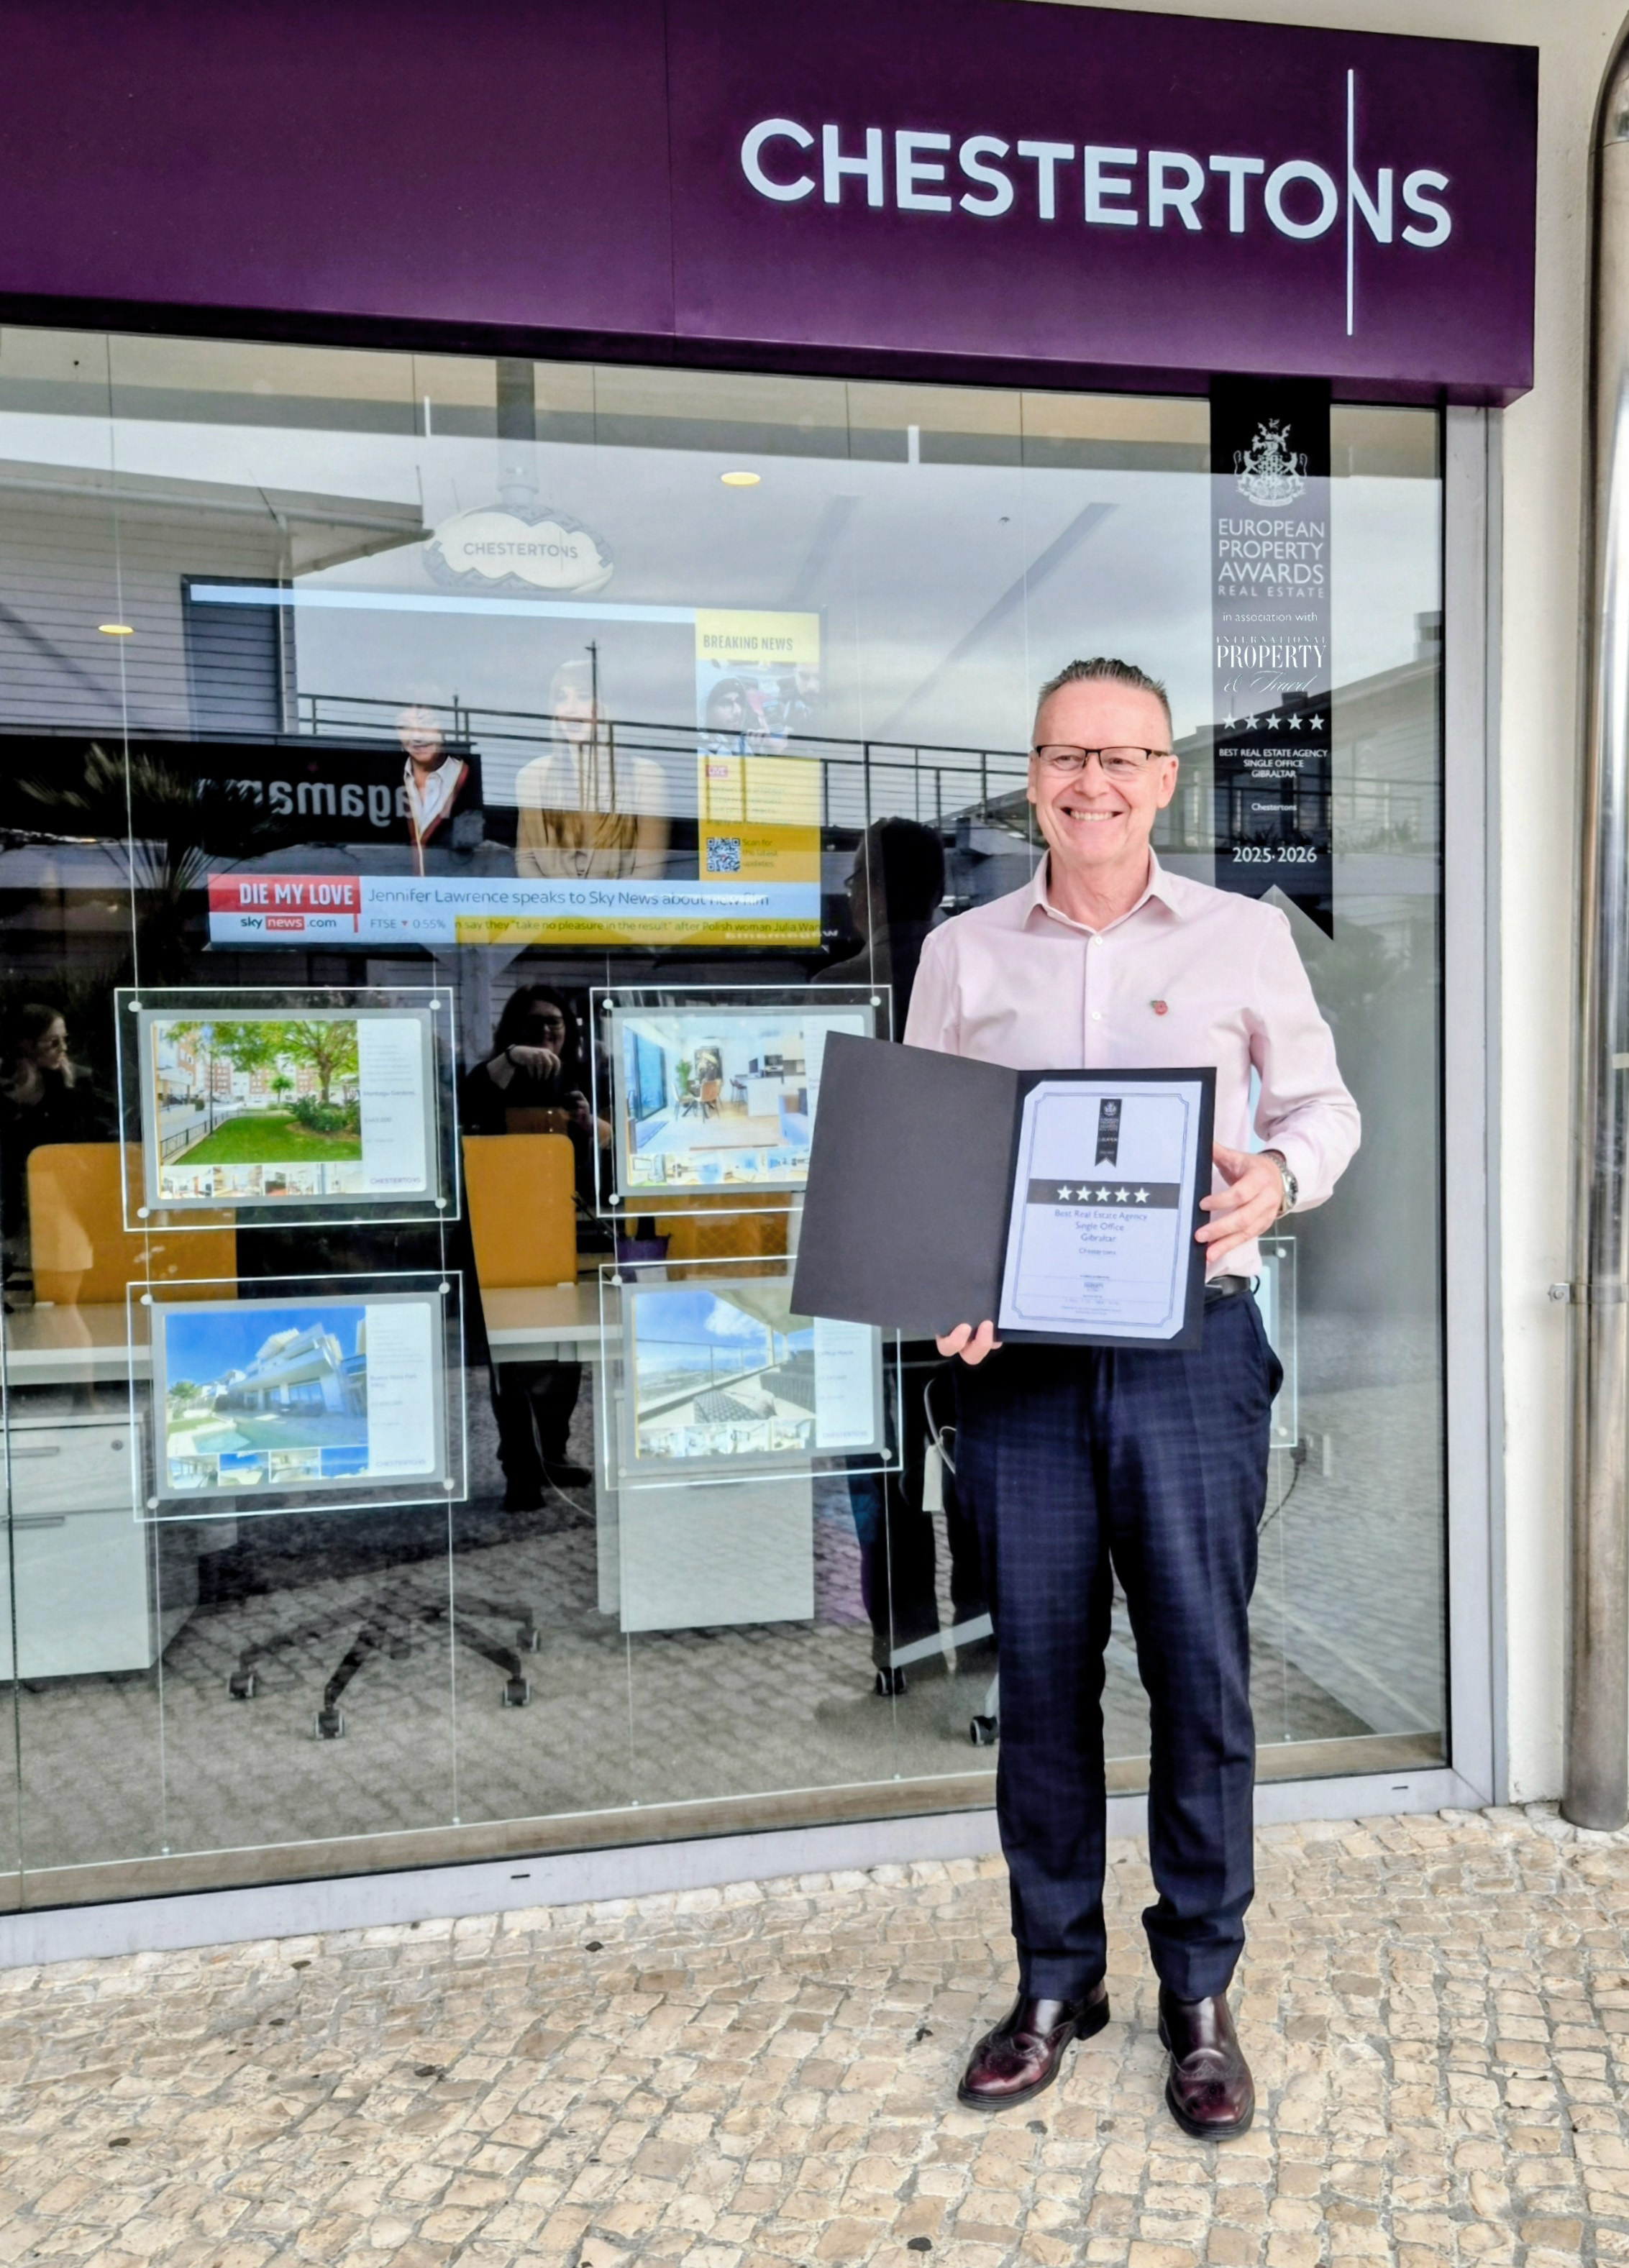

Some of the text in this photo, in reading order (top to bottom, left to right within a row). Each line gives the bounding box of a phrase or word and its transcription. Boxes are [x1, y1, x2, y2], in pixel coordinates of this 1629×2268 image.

[741, 112, 1452, 251] CHESTERTONS
[1218, 518, 1325, 538] EUROPEAN
[463, 542, 578, 559] CHESTERTONS
[1218, 540, 1324, 560] PROPERTY
[1218, 562, 1324, 584] AWARDS
[1218, 585, 1325, 598] REAL ESTATE
[1223, 611, 1318, 622] in association with
[703, 635, 793, 651] BREAKING NEWS
[1217, 645, 1327, 668] PROPERTY
[239, 882, 353, 906] DIE MY LOVE
[368, 888, 431, 903] Jennifer
[434, 890, 508, 903] Lawrence
[513, 891, 565, 907] speaks
[570, 893, 585, 905] to
[589, 892, 616, 908] Sky
[619, 892, 659, 905] News
[662, 892, 706, 905] about
[240, 916, 263, 930] sky
[268, 918, 303, 928] news
[370, 919, 446, 930] FTSE 0.55%
[485, 920, 509, 931] they
[558, 920, 603, 931] pleasure
[606, 921, 616, 930] in
[618, 921, 636, 930] the
[675, 921, 699, 930] after
[703, 922, 732, 931] Polish
[774, 923, 796, 932] Julia
[1093, 1211, 1117, 1220] Estate
[1118, 1212, 1147, 1222] Agency
[1075, 1222, 1124, 1231] Single Office
[1080, 1233, 1116, 1242] Gibraltar
